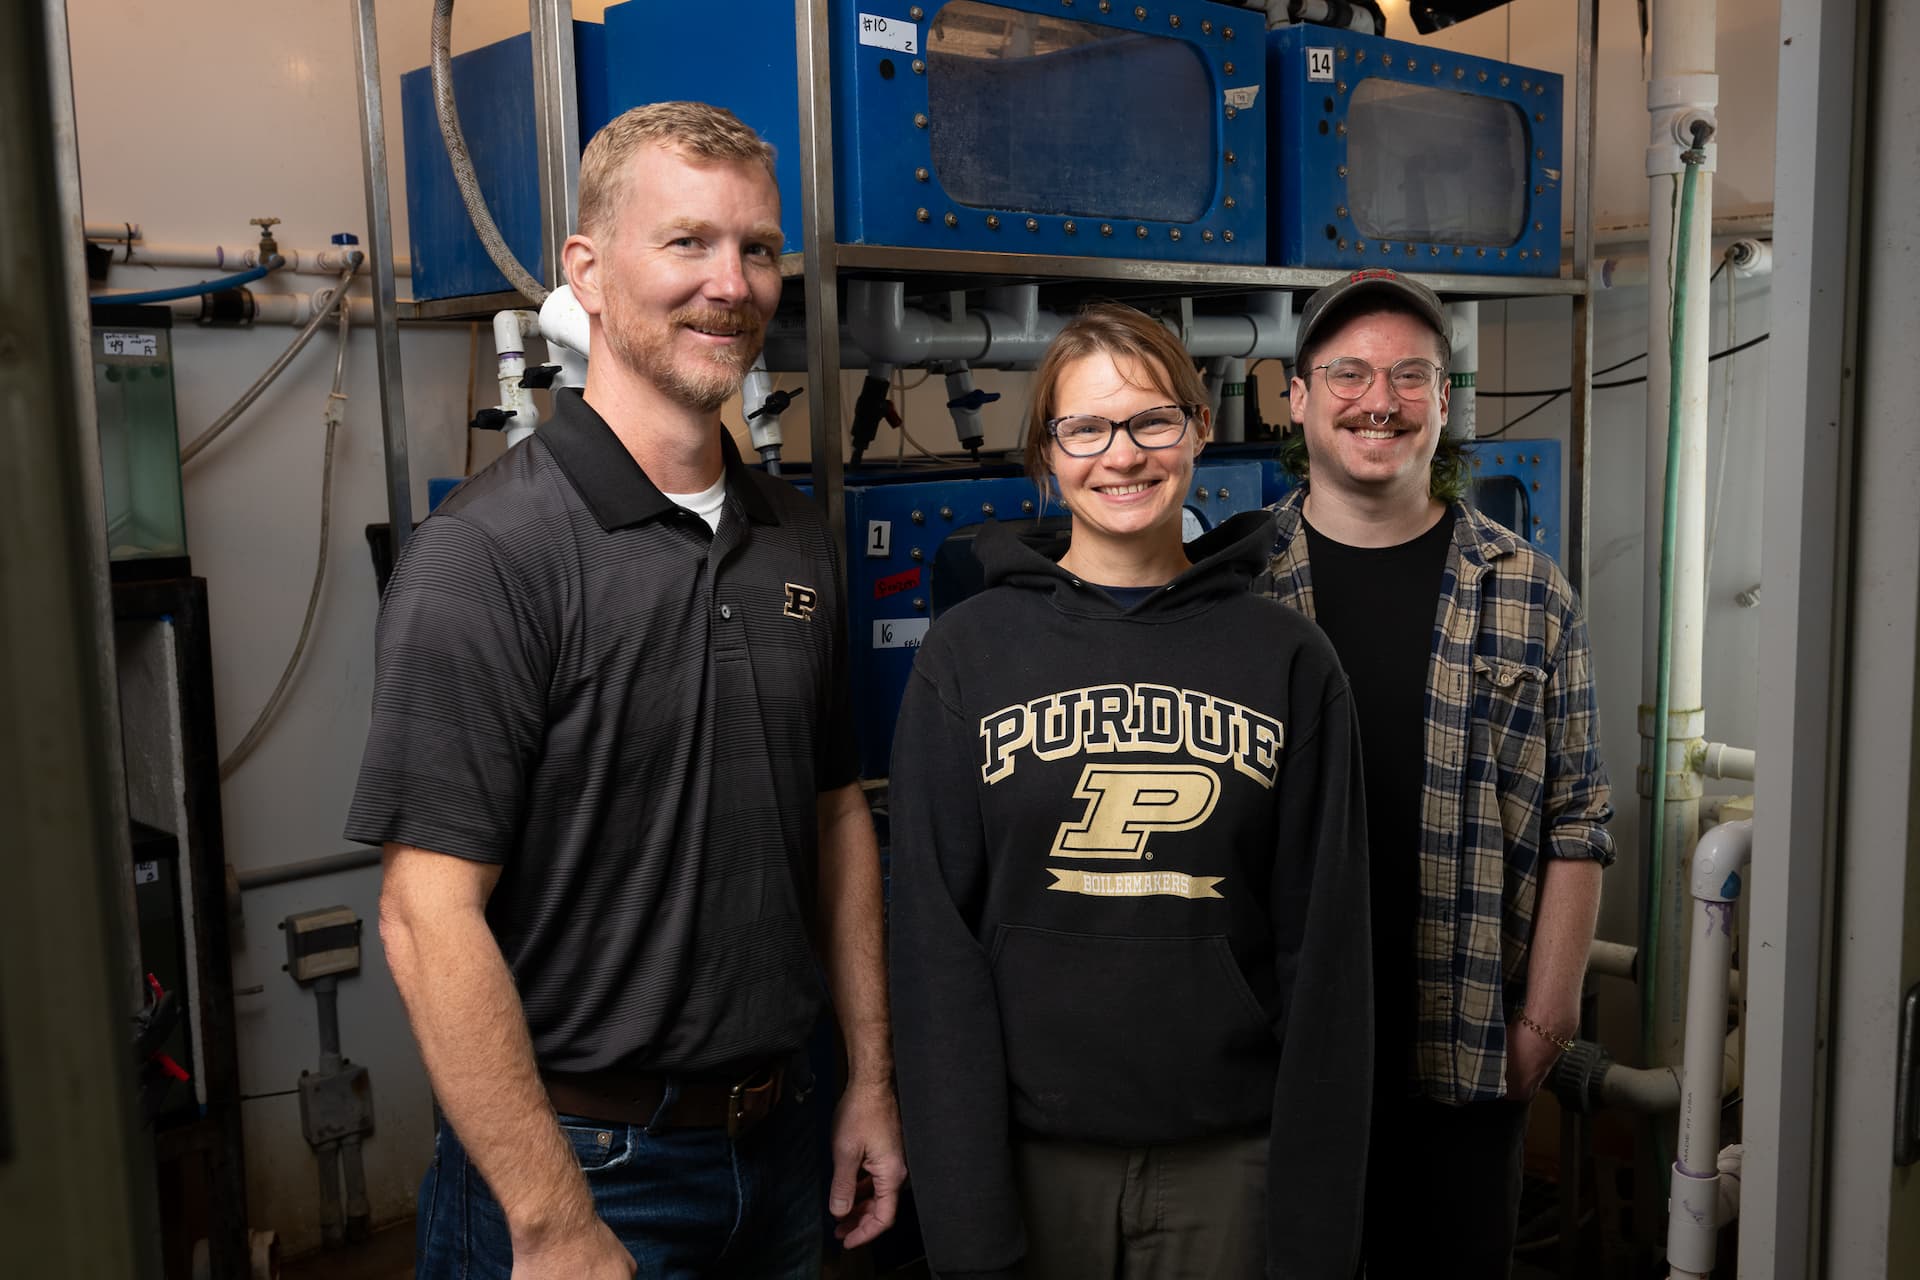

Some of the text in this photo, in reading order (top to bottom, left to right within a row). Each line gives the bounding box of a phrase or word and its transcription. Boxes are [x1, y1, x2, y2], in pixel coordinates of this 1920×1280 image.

[863, 17, 887, 32] #10
[905, 41, 914, 51] 2
[1312, 53, 1331, 74] 14
[872, 525, 885, 549] 1
[784, 582, 817, 619] P
[980, 683, 1285, 789] PURDUE
[1049, 763, 1222, 860] P
[1083, 874, 1190, 895] BOILERMAKERS
